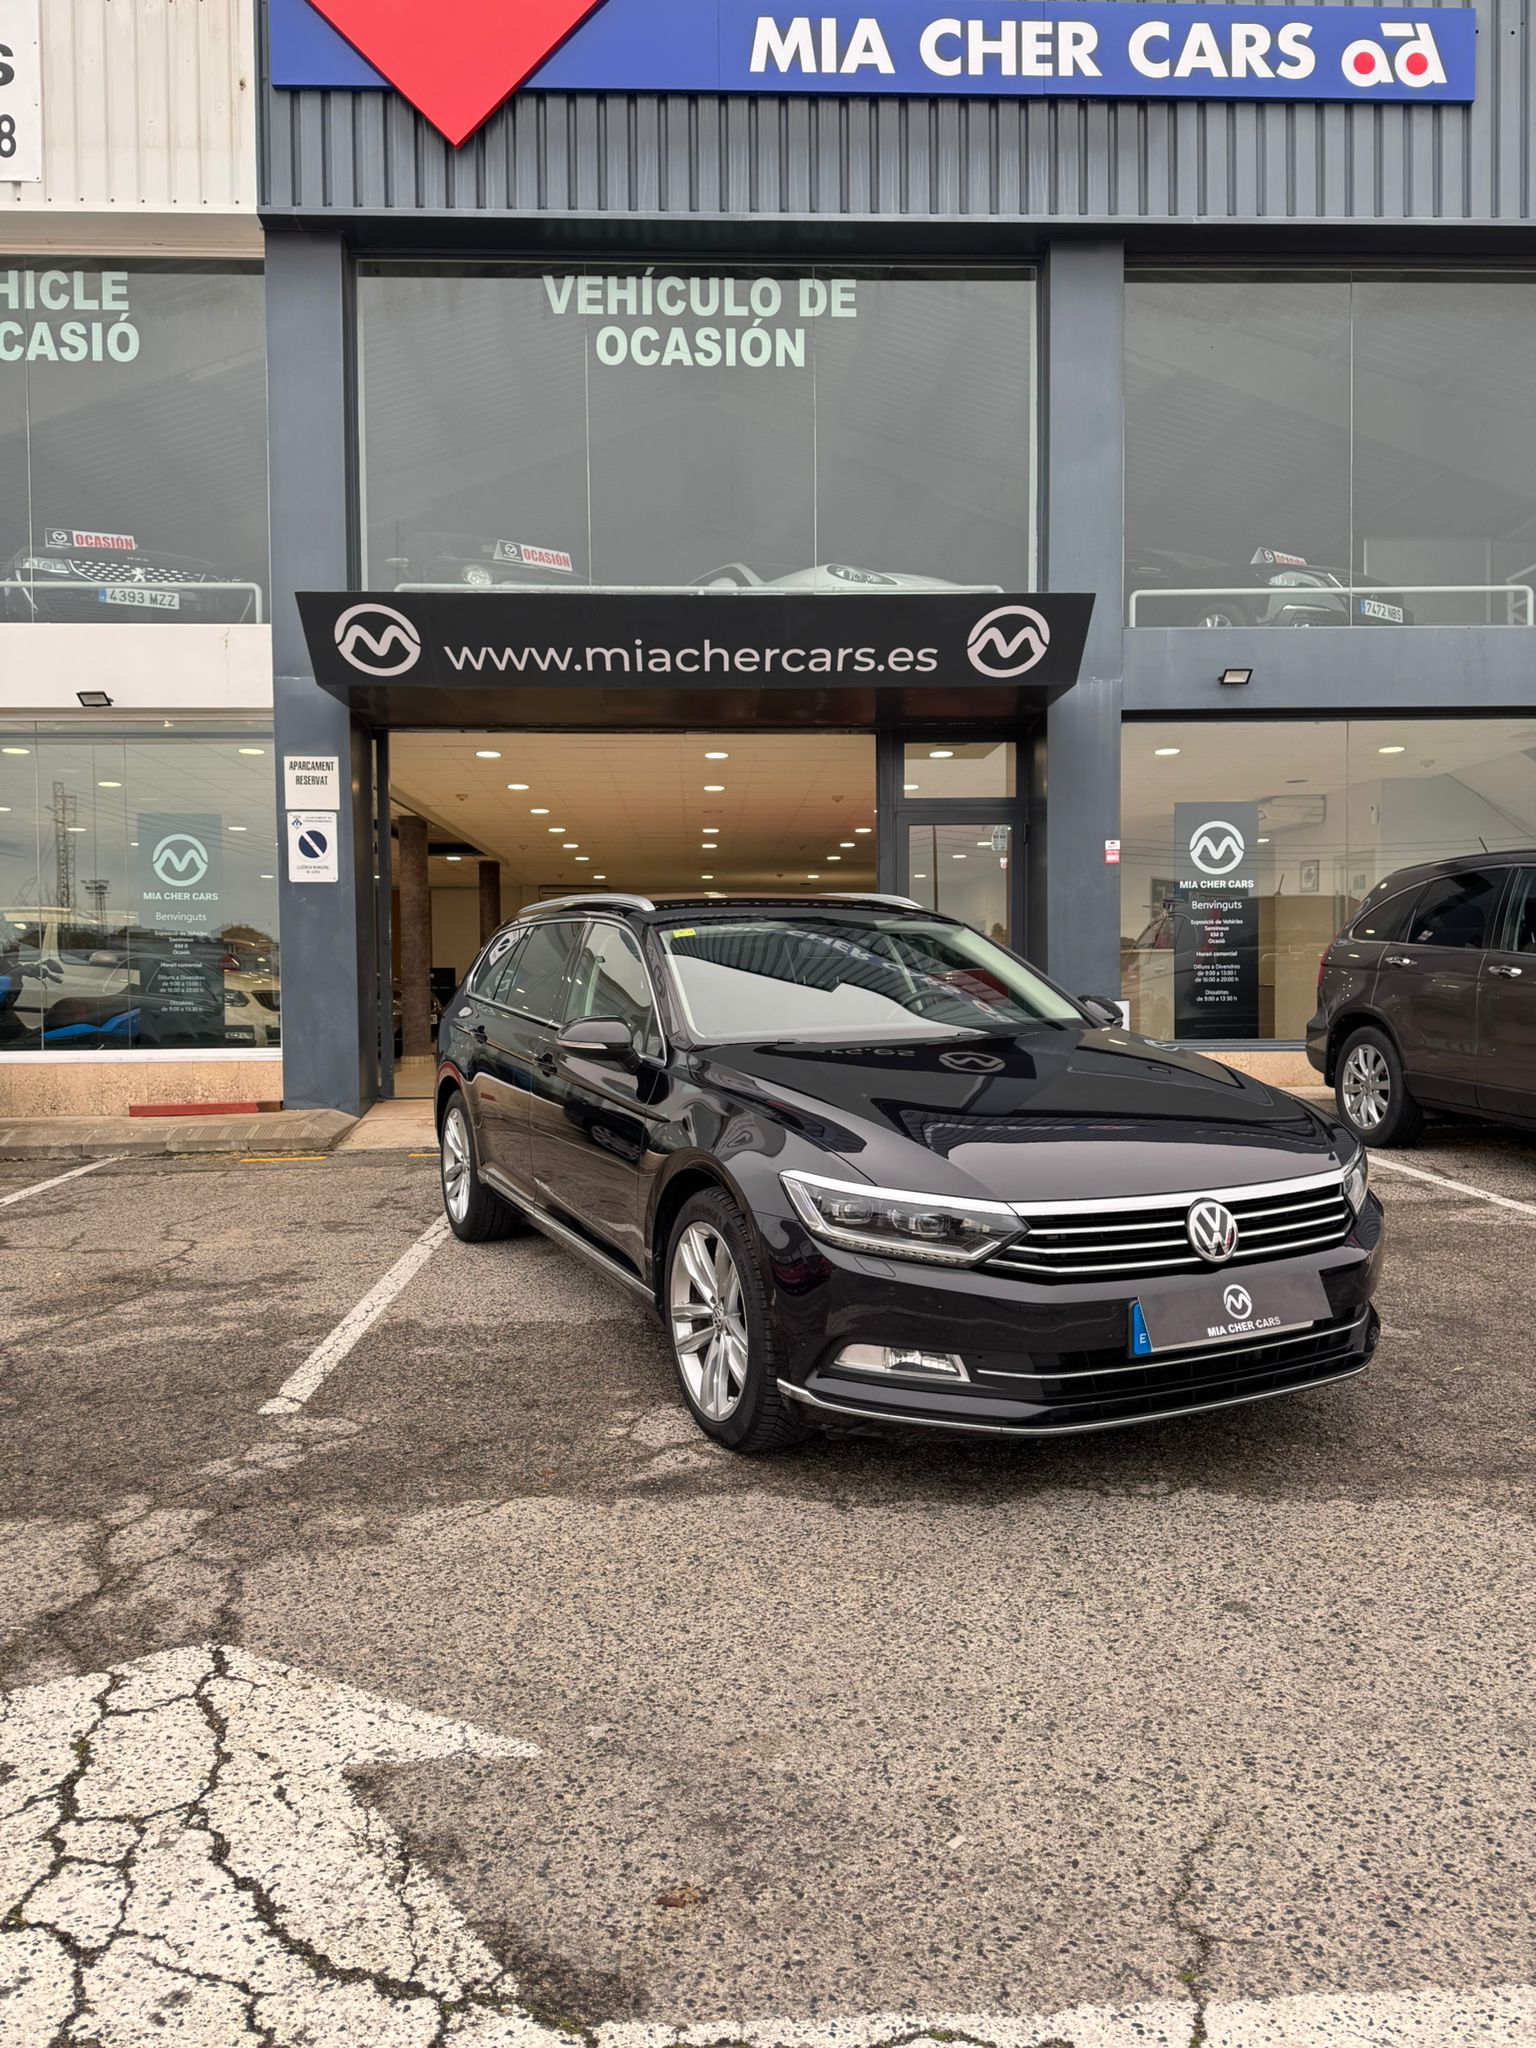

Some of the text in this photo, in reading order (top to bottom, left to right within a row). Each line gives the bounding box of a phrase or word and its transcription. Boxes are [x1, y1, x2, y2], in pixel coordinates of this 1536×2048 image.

[749, 16, 896, 74] MIA
[919, 18, 1103, 77] CHER
[1128, 20, 1316, 79] CARS
[542, 267, 857, 318] VEHÍCULO DE
[596, 318, 805, 367] OCASIÓN
[75, 534, 134, 550] OCASIÓN
[523, 548, 570, 567] OCASIÓN
[109, 590, 176, 607] 4393 MZZ
[1366, 602, 1401, 621] 7472 NBS
[443, 639, 938, 672] www.miachercars.es
[289, 761, 334, 771] APARCAMENT
[296, 775, 328, 785] RESERVAT
[1180, 880, 1254, 889] MIA CHER CARS
[143, 892, 162, 900] MIA
[164, 892, 190, 900] CHER
[1191, 900, 1242, 911] Benvinguts
[155, 912, 207, 923] Benvinguts
[1207, 1316, 1281, 1337] MIA CHER CARS
[1140, 1333, 1146, 1344] E
